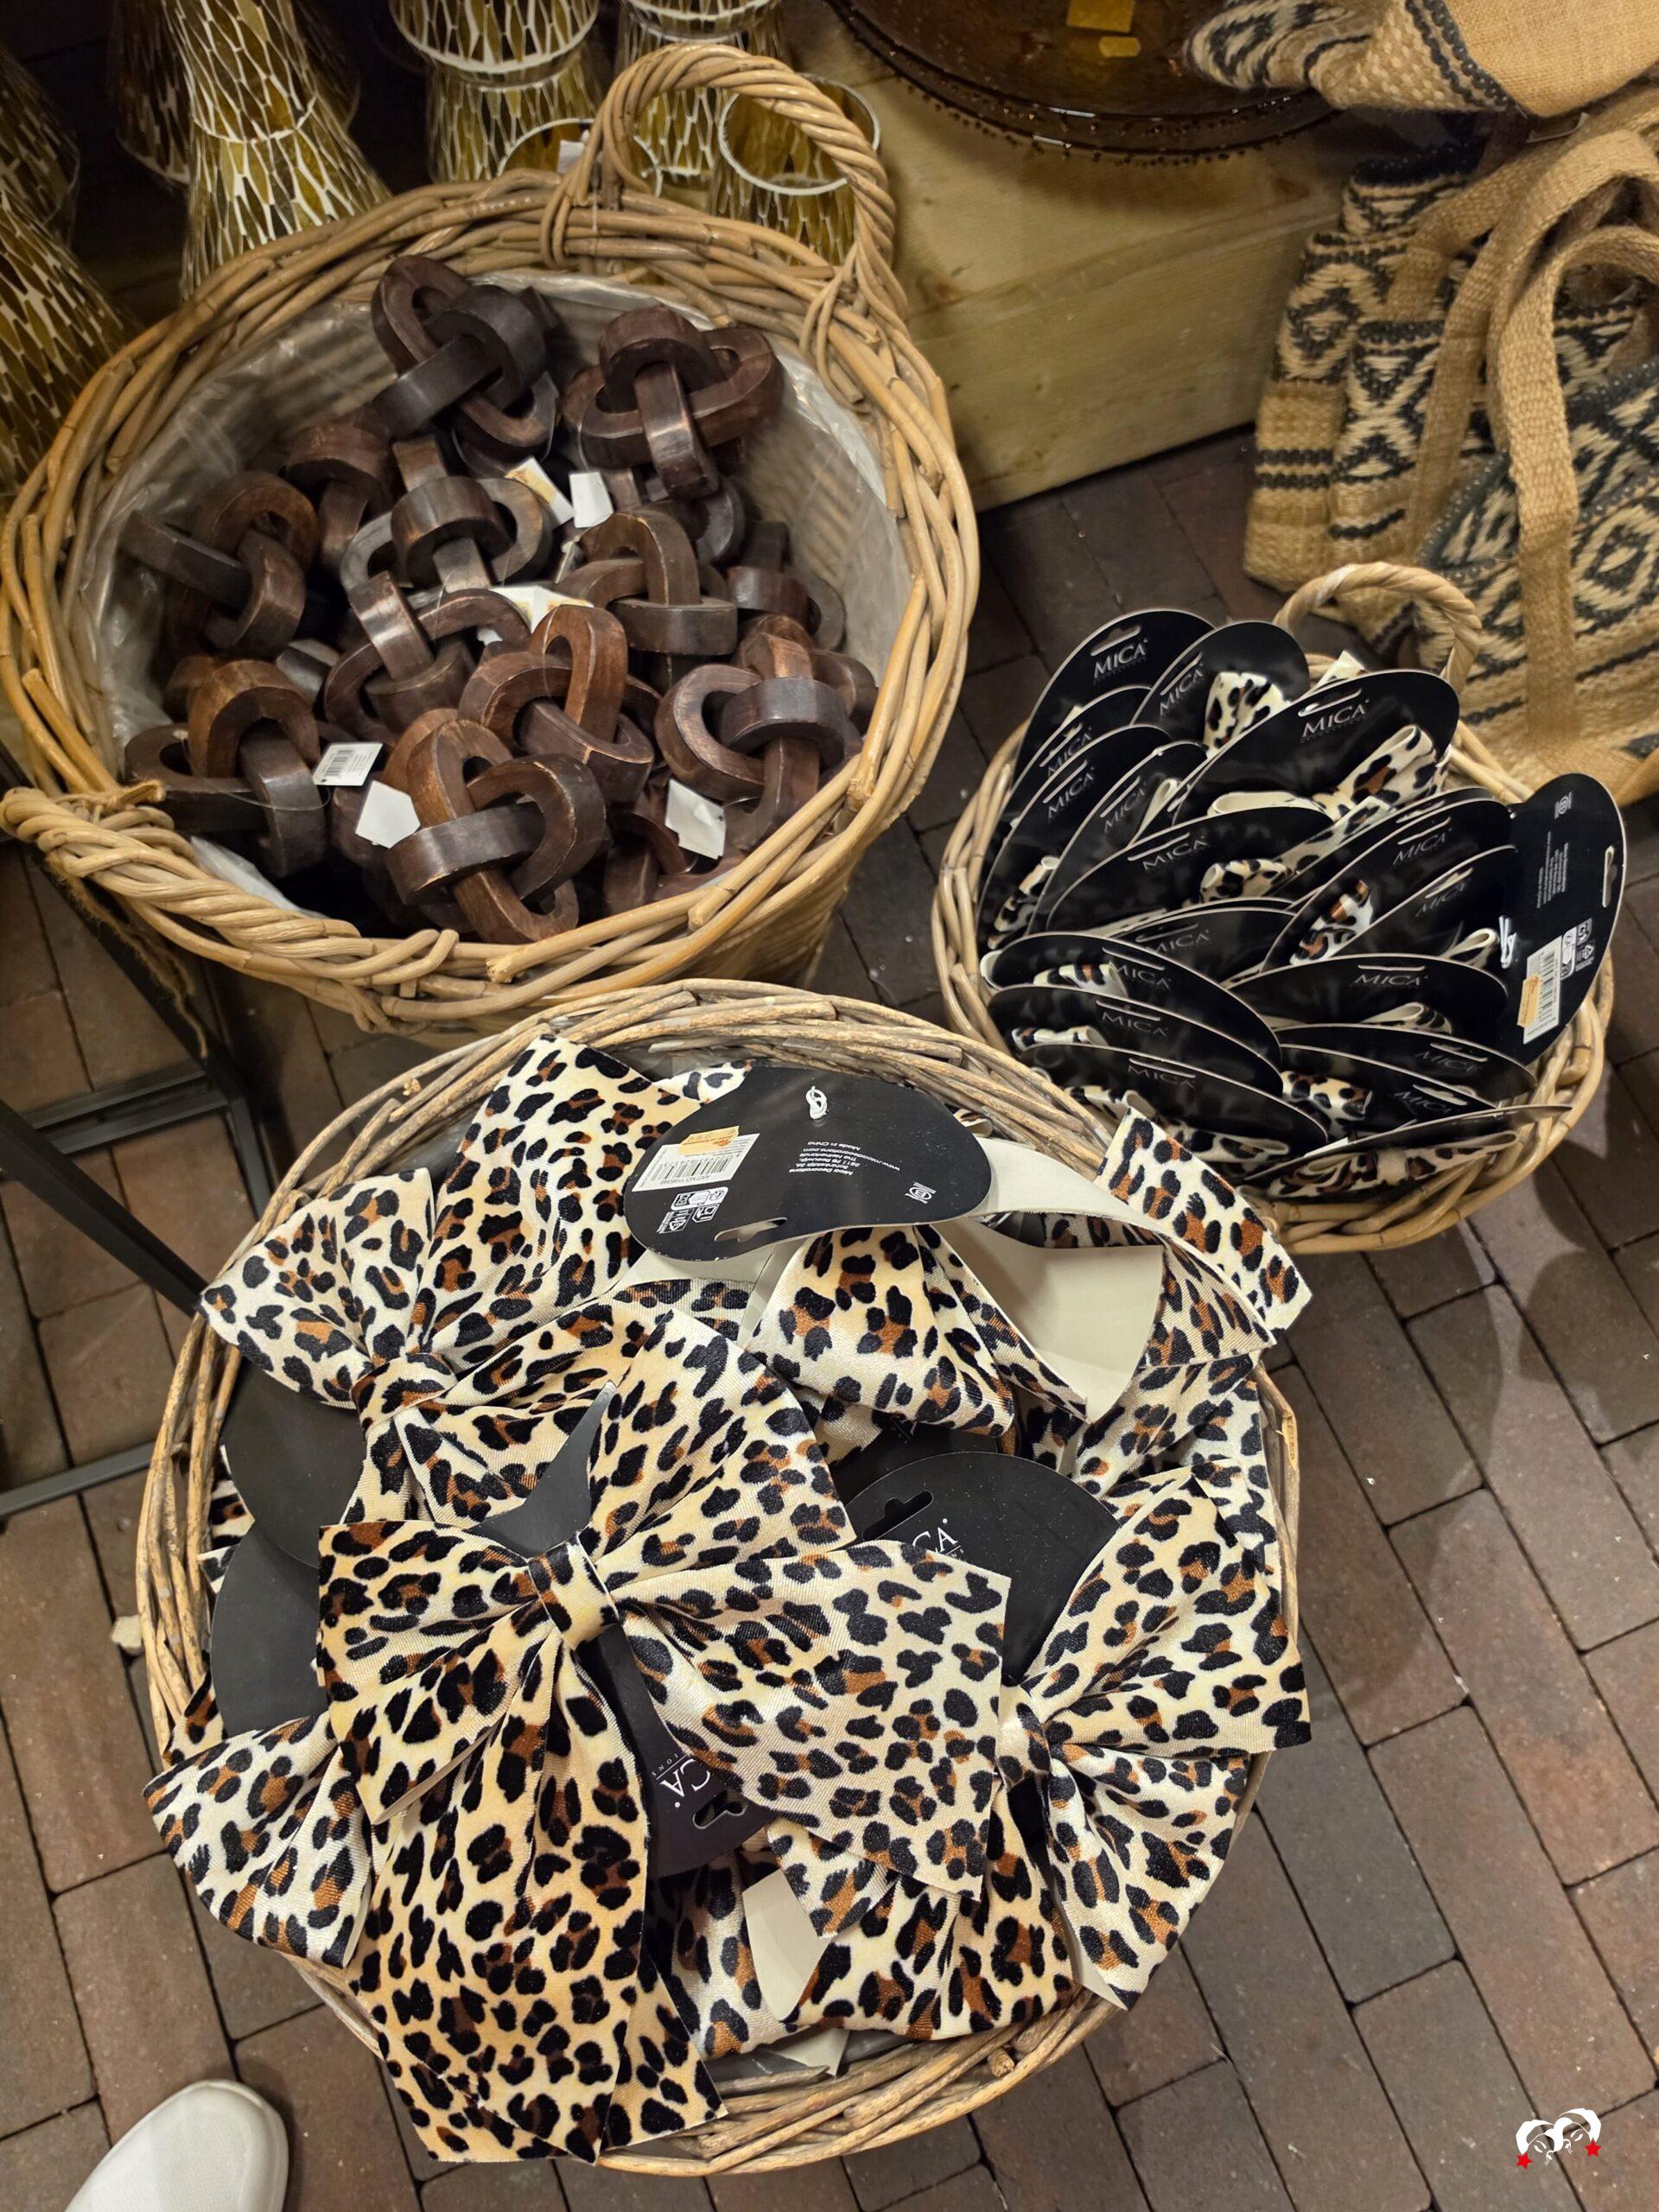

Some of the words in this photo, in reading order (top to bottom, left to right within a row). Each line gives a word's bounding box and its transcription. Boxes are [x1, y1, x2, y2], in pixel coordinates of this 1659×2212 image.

[1093, 644, 1147, 677] MICA
[1160, 669, 1203, 715] MICA
[1301, 704, 1365, 737] MICA
[1047, 774, 1095, 818] MICA
[1142, 840, 1209, 871] MICA
[1393, 832, 1446, 864] MICA
[1354, 974, 1421, 986] MICA
[1102, 1011, 1168, 1039] MICA
[1128, 1065, 1194, 1089] MICA
[838, 1142, 861, 1151] Made
[912, 1527, 959, 1553] CA
[659, 1758, 711, 1797] CA
